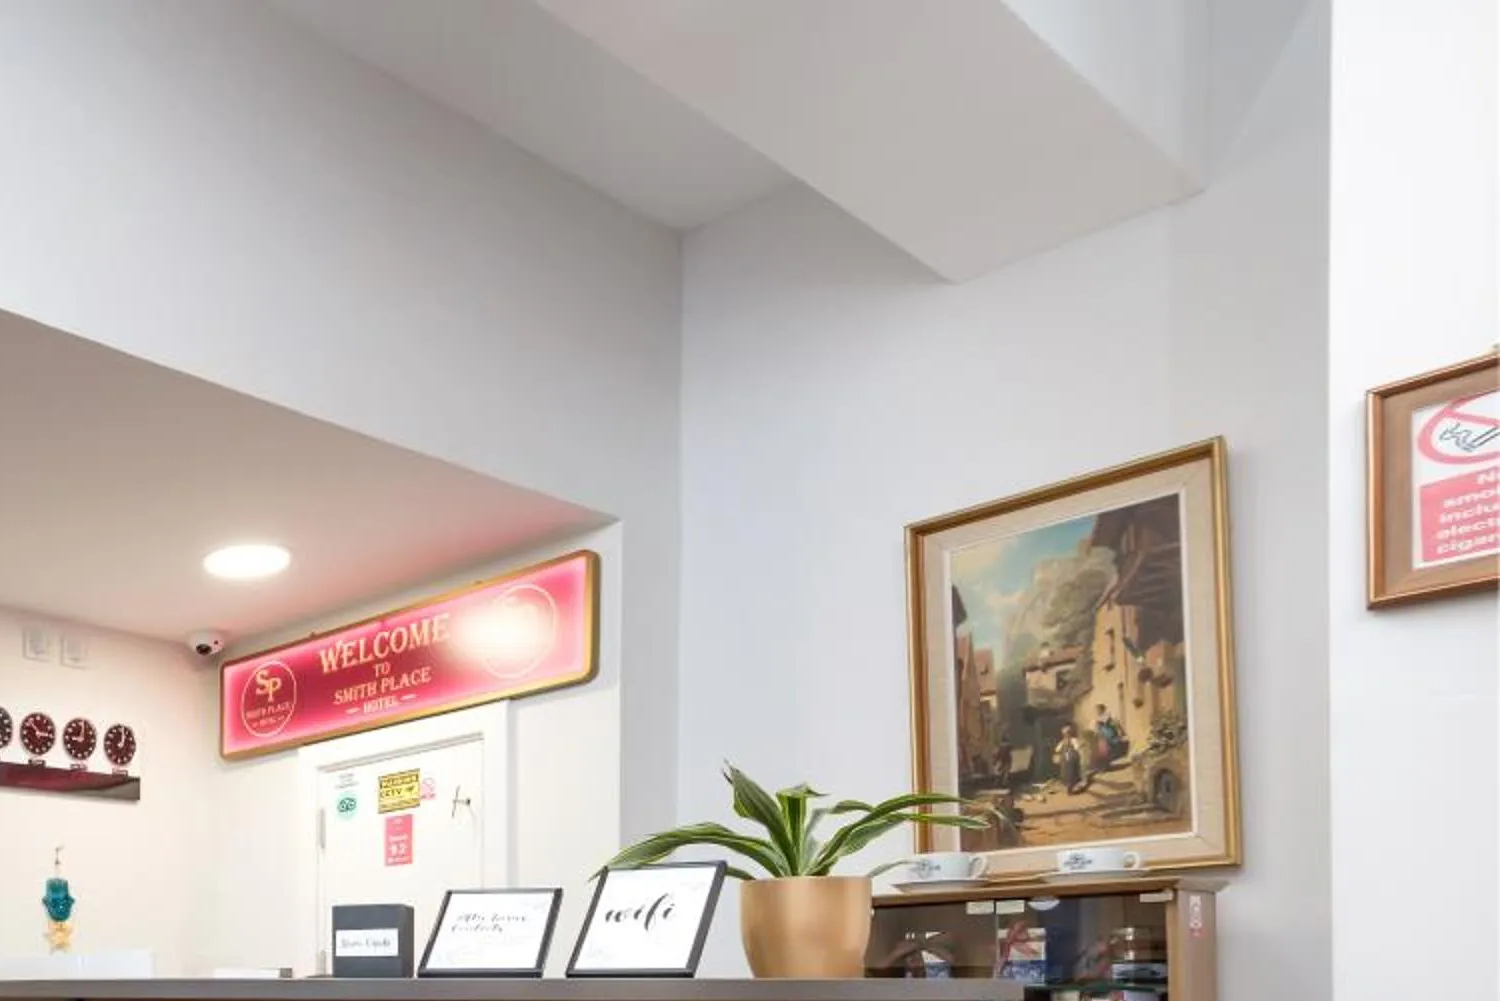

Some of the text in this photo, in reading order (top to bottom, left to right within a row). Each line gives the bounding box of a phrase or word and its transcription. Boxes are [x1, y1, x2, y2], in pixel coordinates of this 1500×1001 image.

[319, 613, 450, 675] WELCOME
[333, 666, 432, 705] SMITH PLACE
[373, 661, 391, 678] TO
